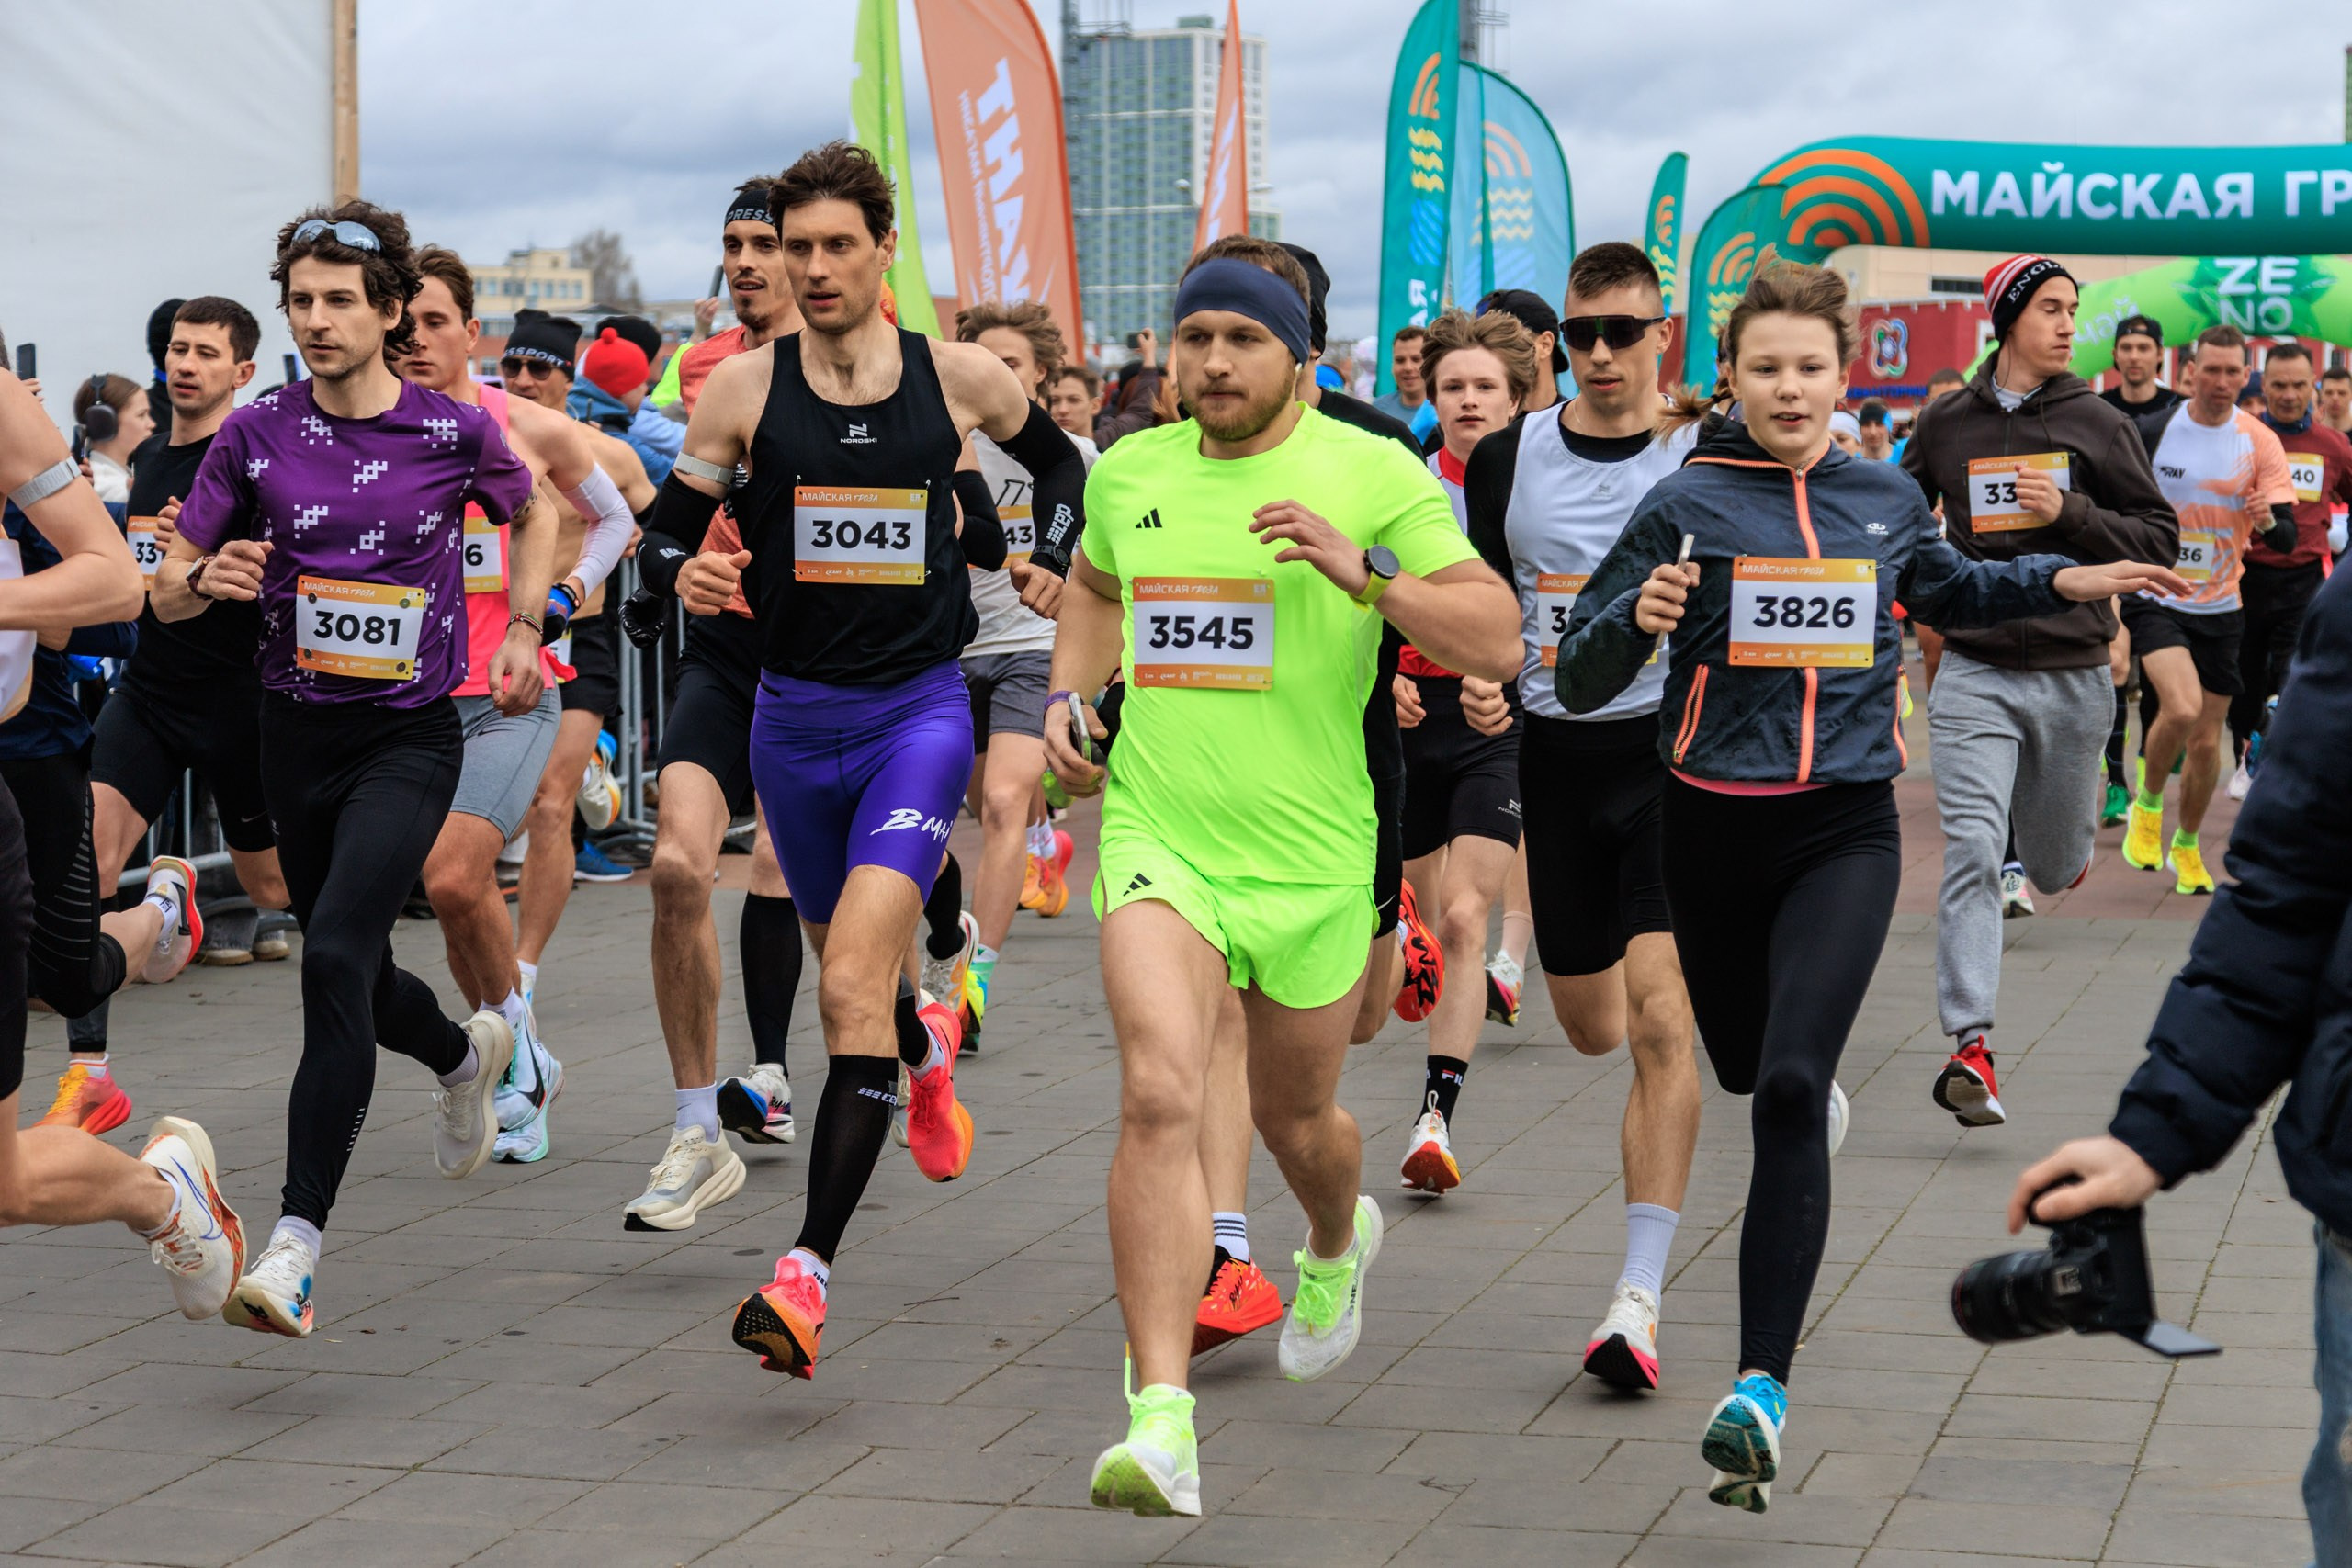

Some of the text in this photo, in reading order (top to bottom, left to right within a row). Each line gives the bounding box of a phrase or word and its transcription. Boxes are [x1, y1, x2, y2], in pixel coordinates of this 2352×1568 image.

[1931, 161, 2255, 220] МАЙСКАЯ
[726, 209, 774, 223] PRESS
[2007, 261, 2064, 304] ENGL
[2214, 257, 2299, 294] ZE
[2219, 296, 2294, 333] NO
[802, 491, 878, 502] МАЙСКАЯ ГРОЗА
[811, 520, 911, 550] 3043
[135, 542, 165, 563] 33
[1741, 563, 1798, 575] МАЙСКАЯ
[304, 582, 349, 595] МАЙСКАЯ
[1139, 583, 1189, 594] МАЙСКАЯ
[1551, 605, 1573, 634] 3
[1752, 595, 1856, 628] 3826
[313, 610, 401, 646] 3081
[1148, 615, 1254, 649] 3545
